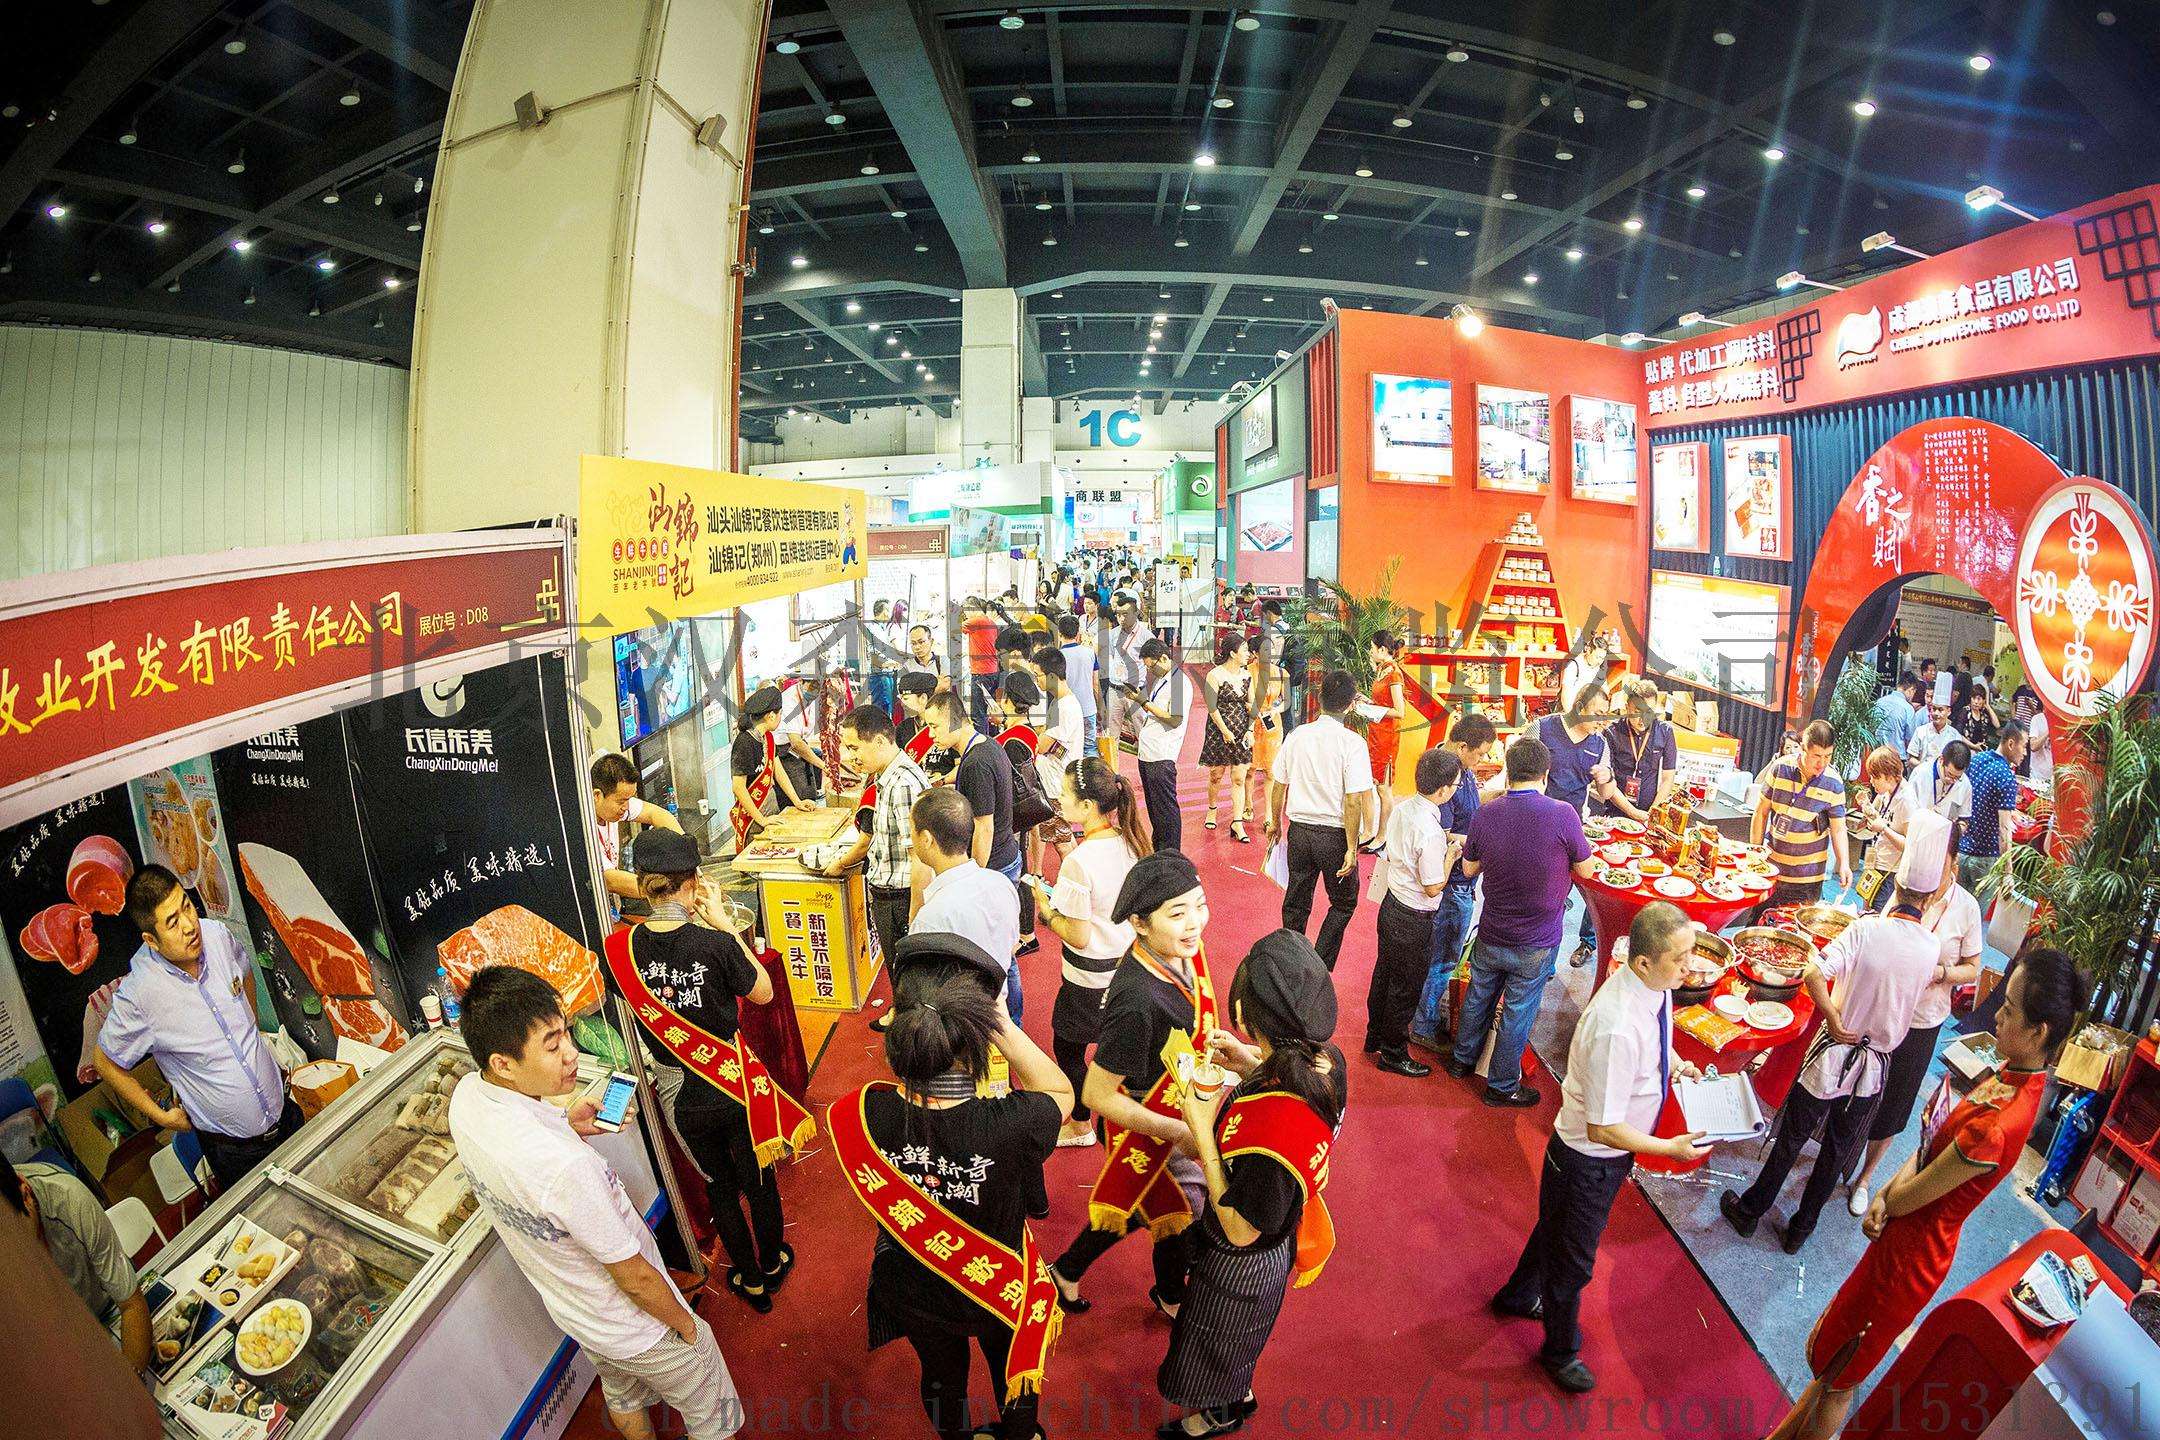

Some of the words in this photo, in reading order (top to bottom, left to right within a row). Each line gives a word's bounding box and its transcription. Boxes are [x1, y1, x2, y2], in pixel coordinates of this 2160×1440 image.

[1996, 306, 2029, 330] FOOD
[1644, 354, 1676, 385] 贴牌
[1078, 409, 1142, 448] 1C
[1065, 490, 1122, 503] 商联盟
[613, 564, 657, 582] SHANJINJI
[405, 727, 494, 755] 长信东美
[246, 747, 304, 763] ChangXinDongMei
[405, 755, 499, 774] ChangXinDongMei
[782, 899, 809, 980] 一餐一头牛
[807, 913, 834, 998] 新鲜不隔夜
